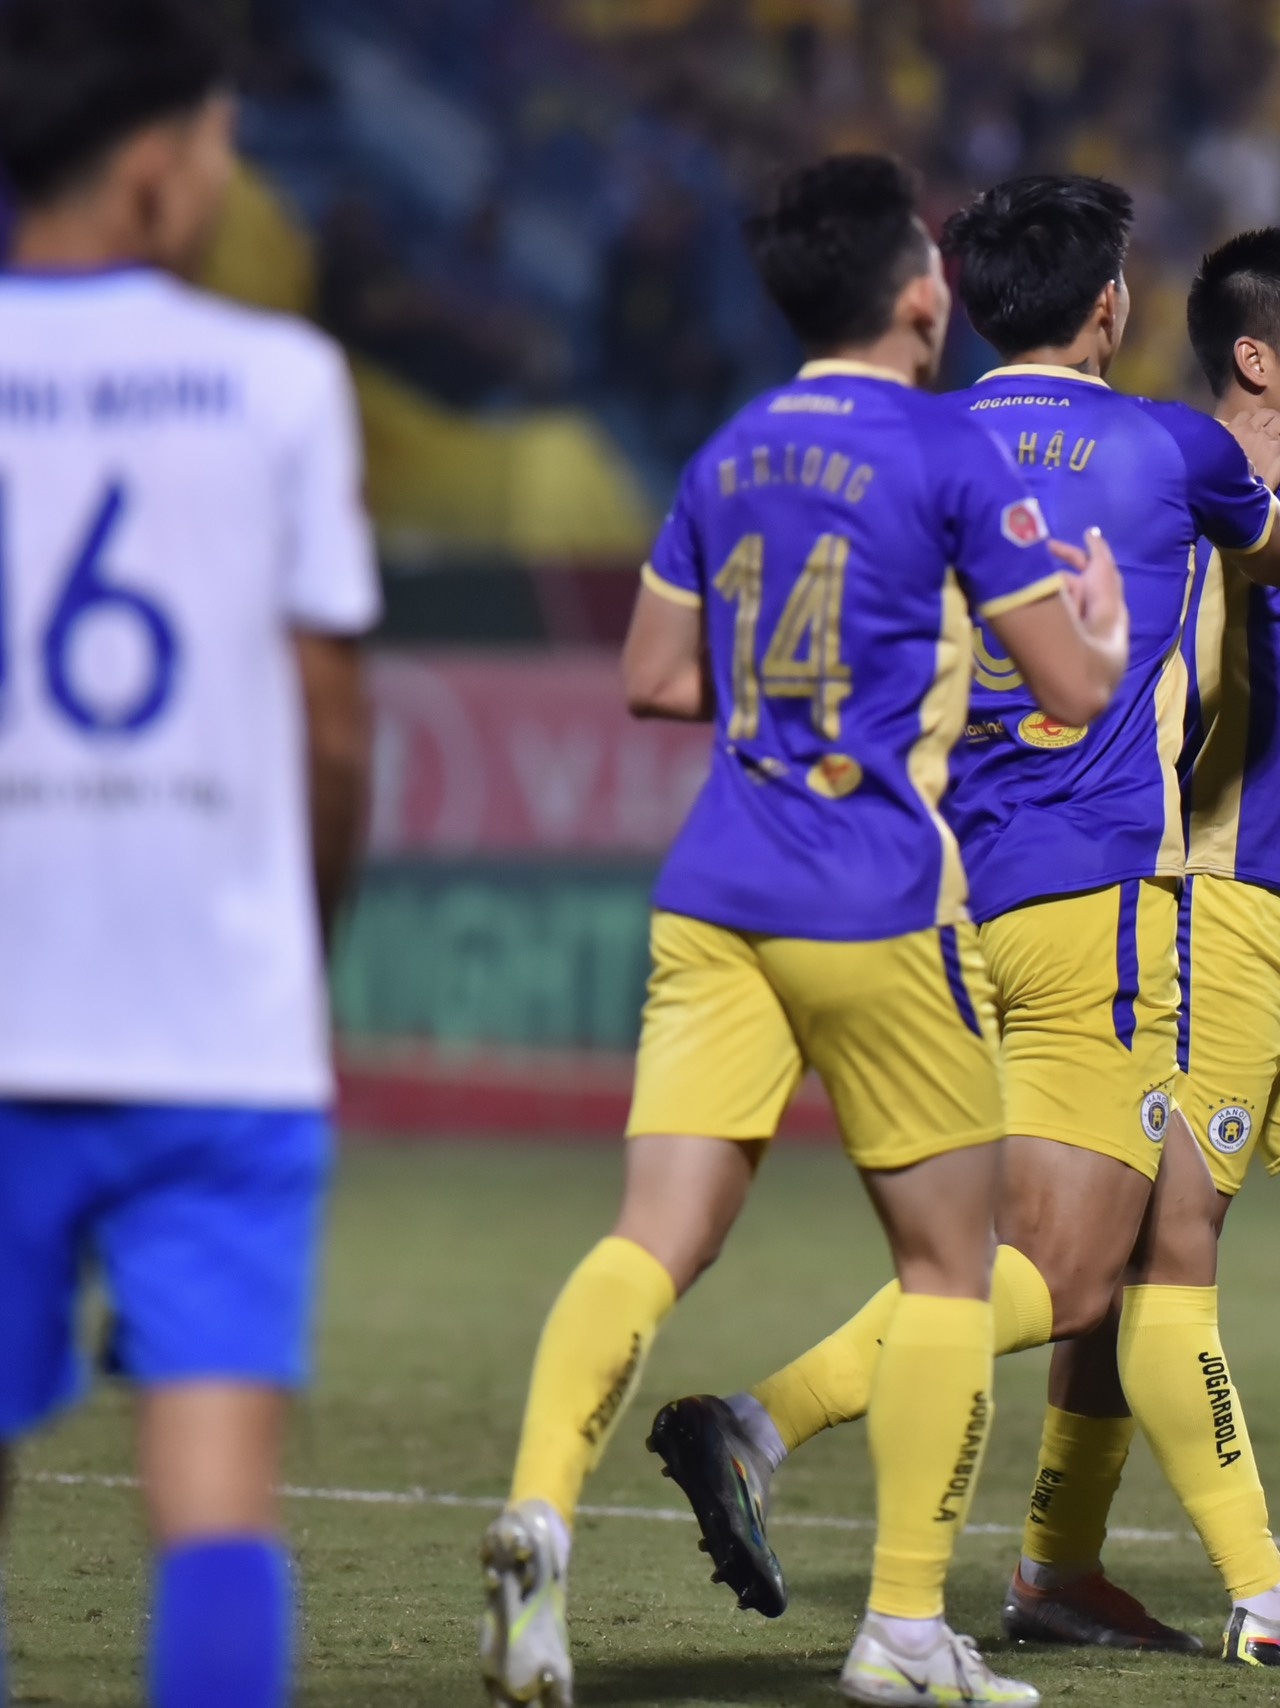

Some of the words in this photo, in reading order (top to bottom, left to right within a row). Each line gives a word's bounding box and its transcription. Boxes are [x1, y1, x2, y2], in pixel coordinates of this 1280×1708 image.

[1017, 430, 1096, 472] HẬU
[712, 532, 853, 741] 14
[1217, 1109, 1247, 1120] HANOI
[931, 1390, 988, 1522] JOGARBOLA
[1198, 1351, 1242, 1468] JOGARBOLA
